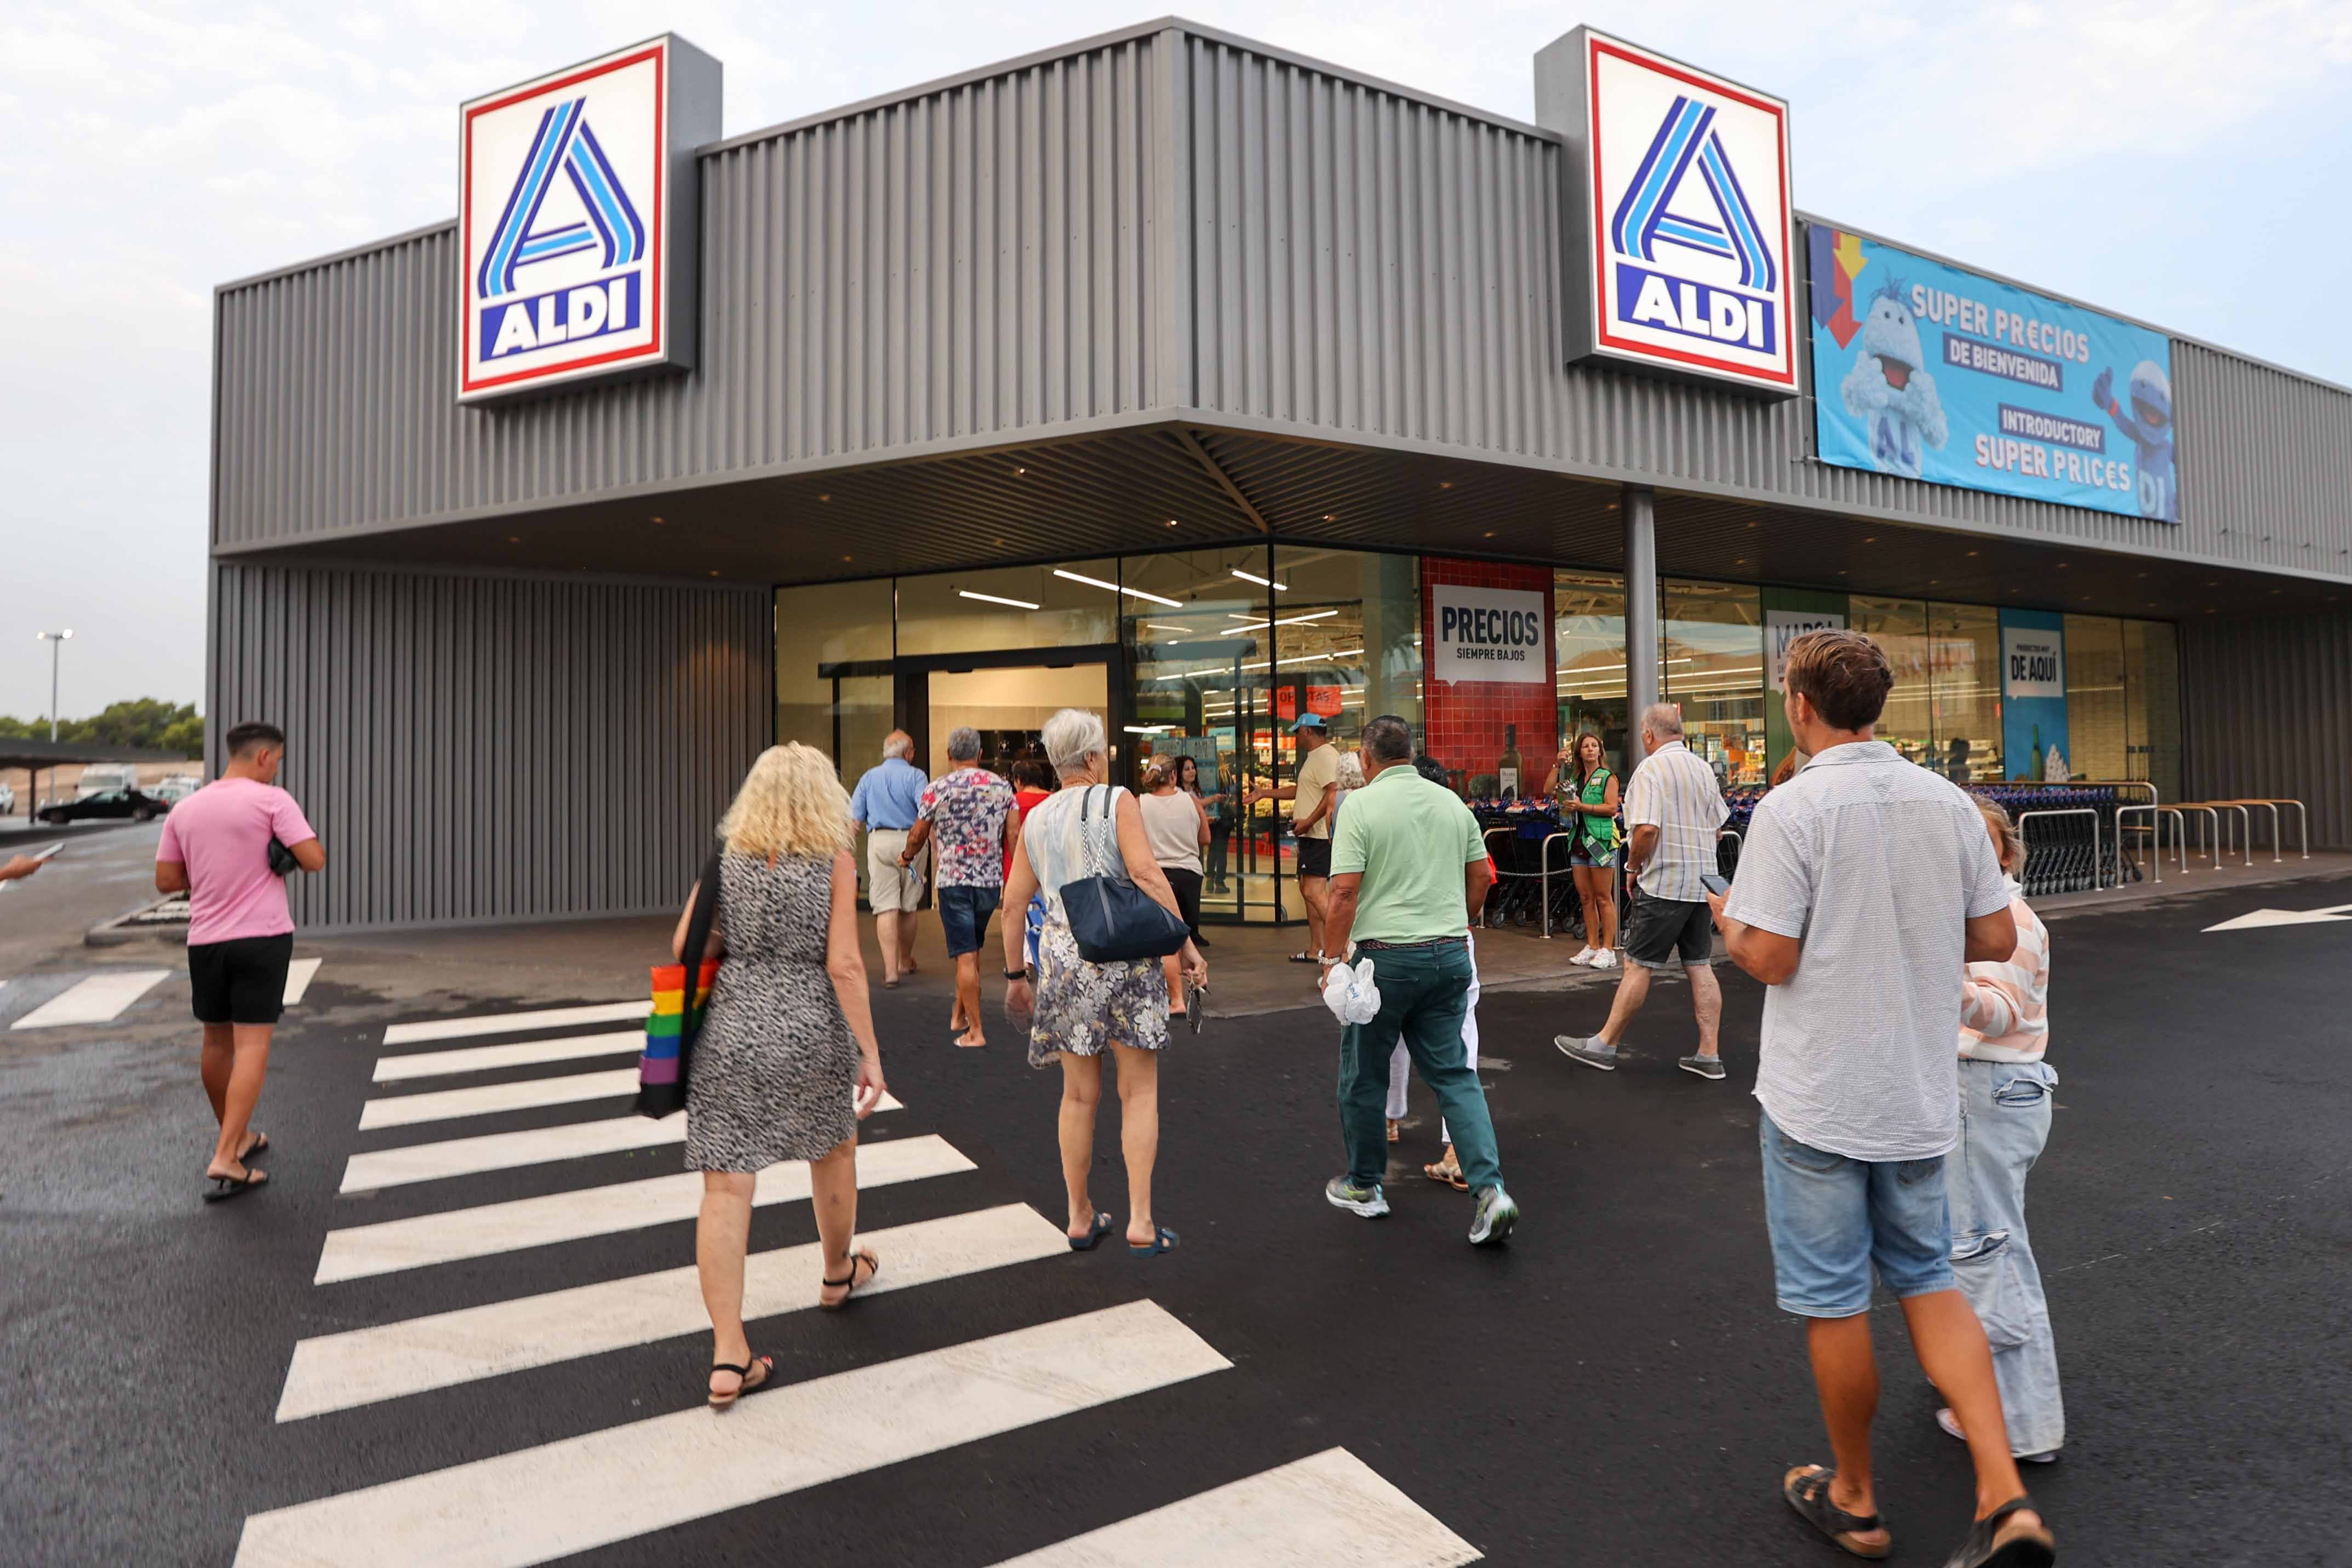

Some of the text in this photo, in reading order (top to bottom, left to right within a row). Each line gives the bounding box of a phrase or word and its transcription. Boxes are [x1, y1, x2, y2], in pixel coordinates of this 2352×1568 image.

[491, 277, 627, 357] ALDI
[1631, 274, 1764, 348] ALDI
[1911, 283, 1989, 337] SUPER
[1949, 338, 2059, 387] DE BIENVENIDA
[2002, 409, 2102, 449] INTRODUCTORY
[1975, 433, 2050, 479] SUPER
[1442, 606, 1539, 646] PRECIOS
[1457, 647, 1525, 661] SIEMPRE BAJOS
[2011, 651, 2057, 682] DE AQUÍ
